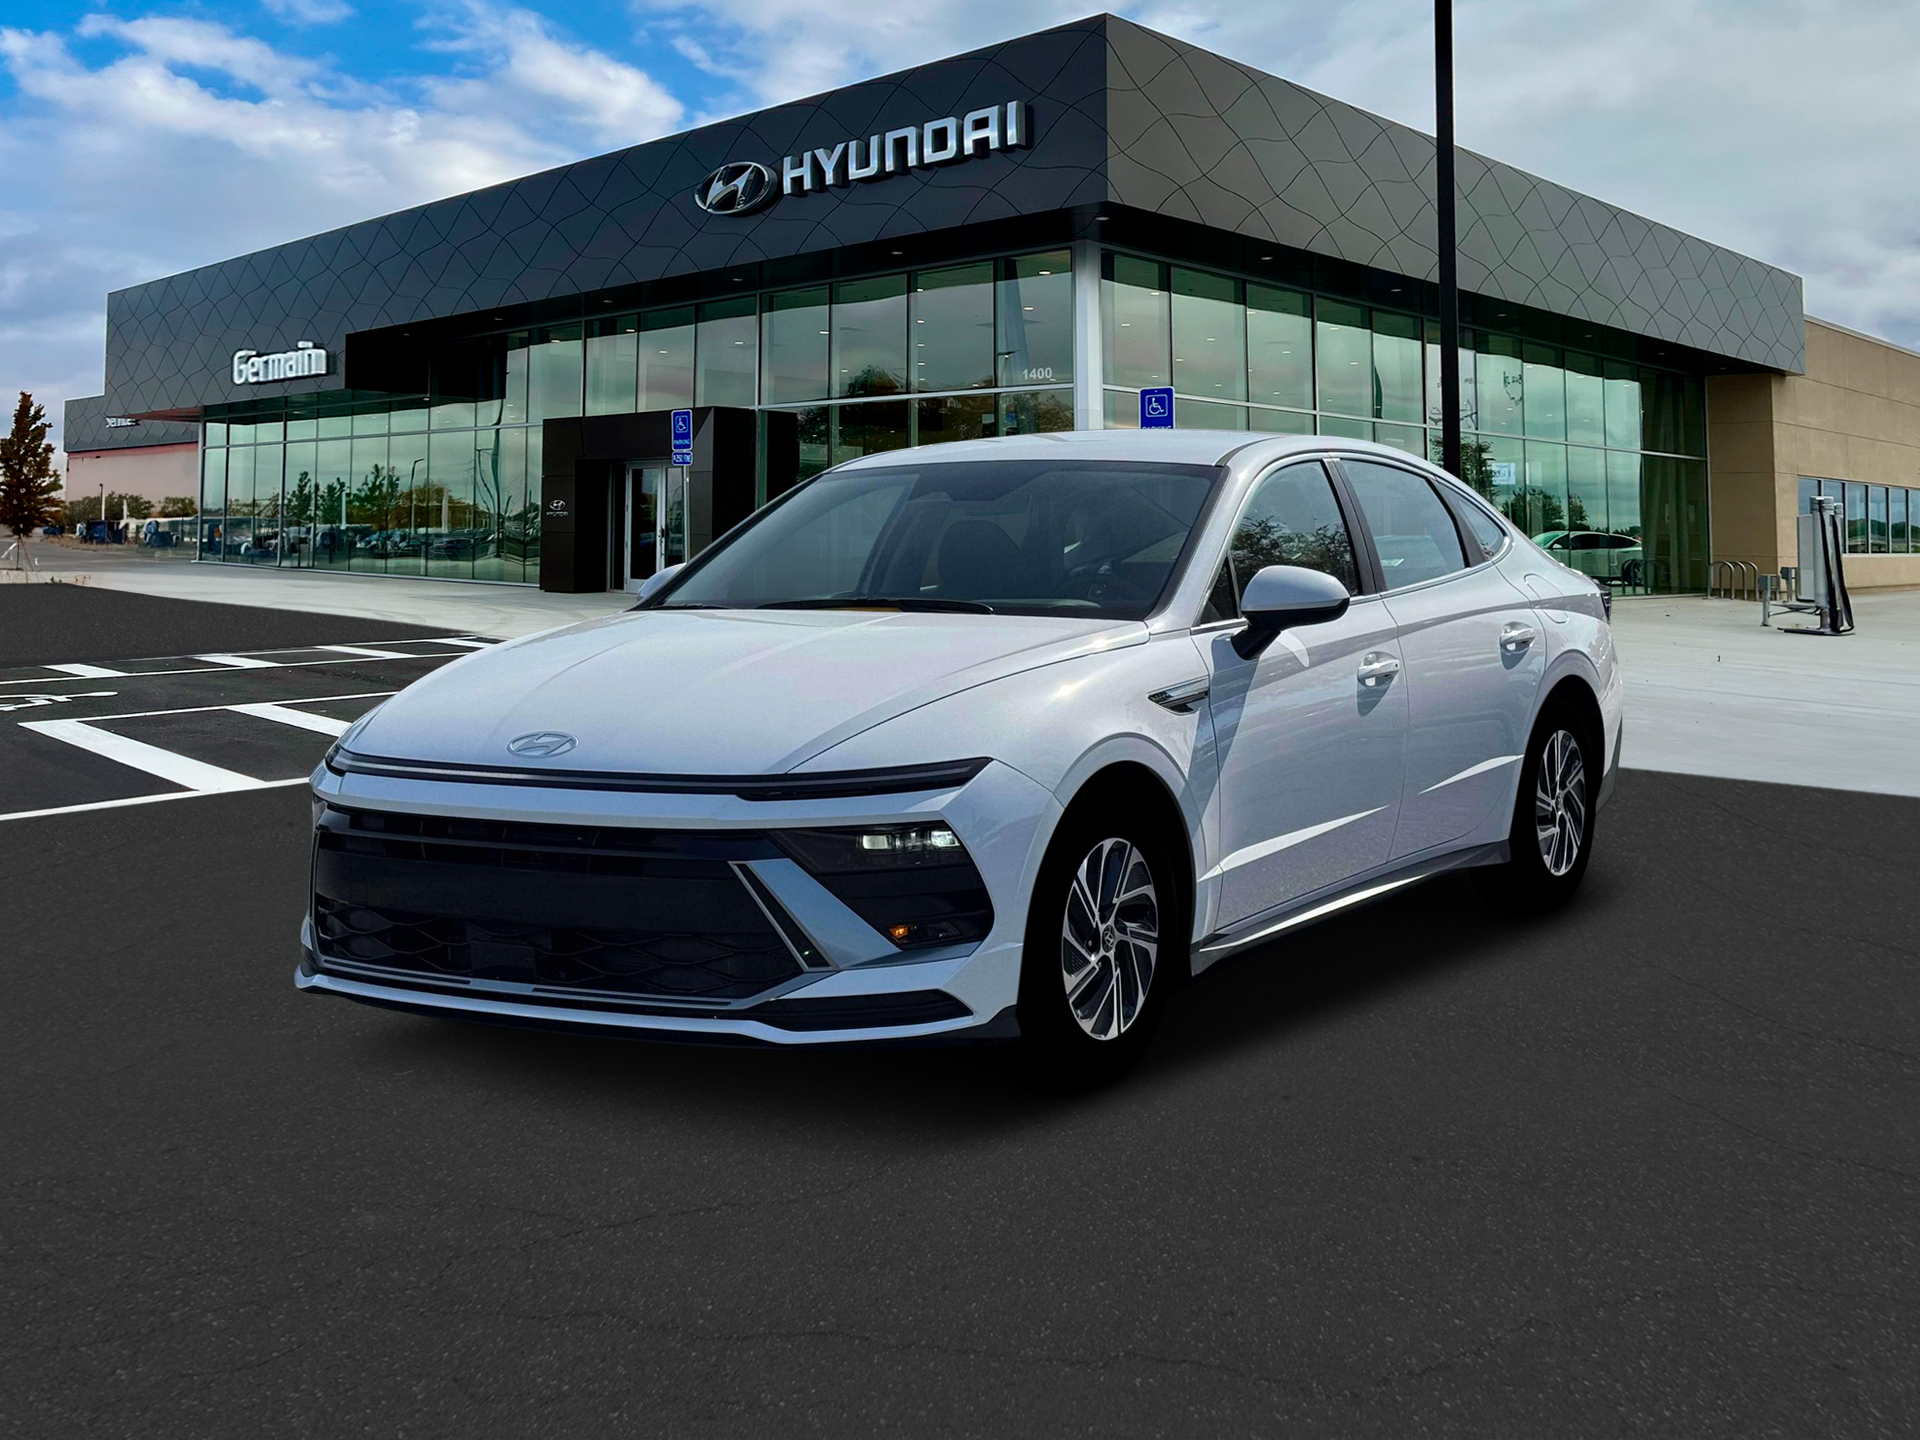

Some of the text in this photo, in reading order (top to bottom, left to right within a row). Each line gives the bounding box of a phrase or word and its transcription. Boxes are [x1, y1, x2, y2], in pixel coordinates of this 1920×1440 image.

[782, 100, 1025, 195] HYUNDAI
[233, 341, 327, 385] Germain
[1022, 367, 1053, 380] 1400
